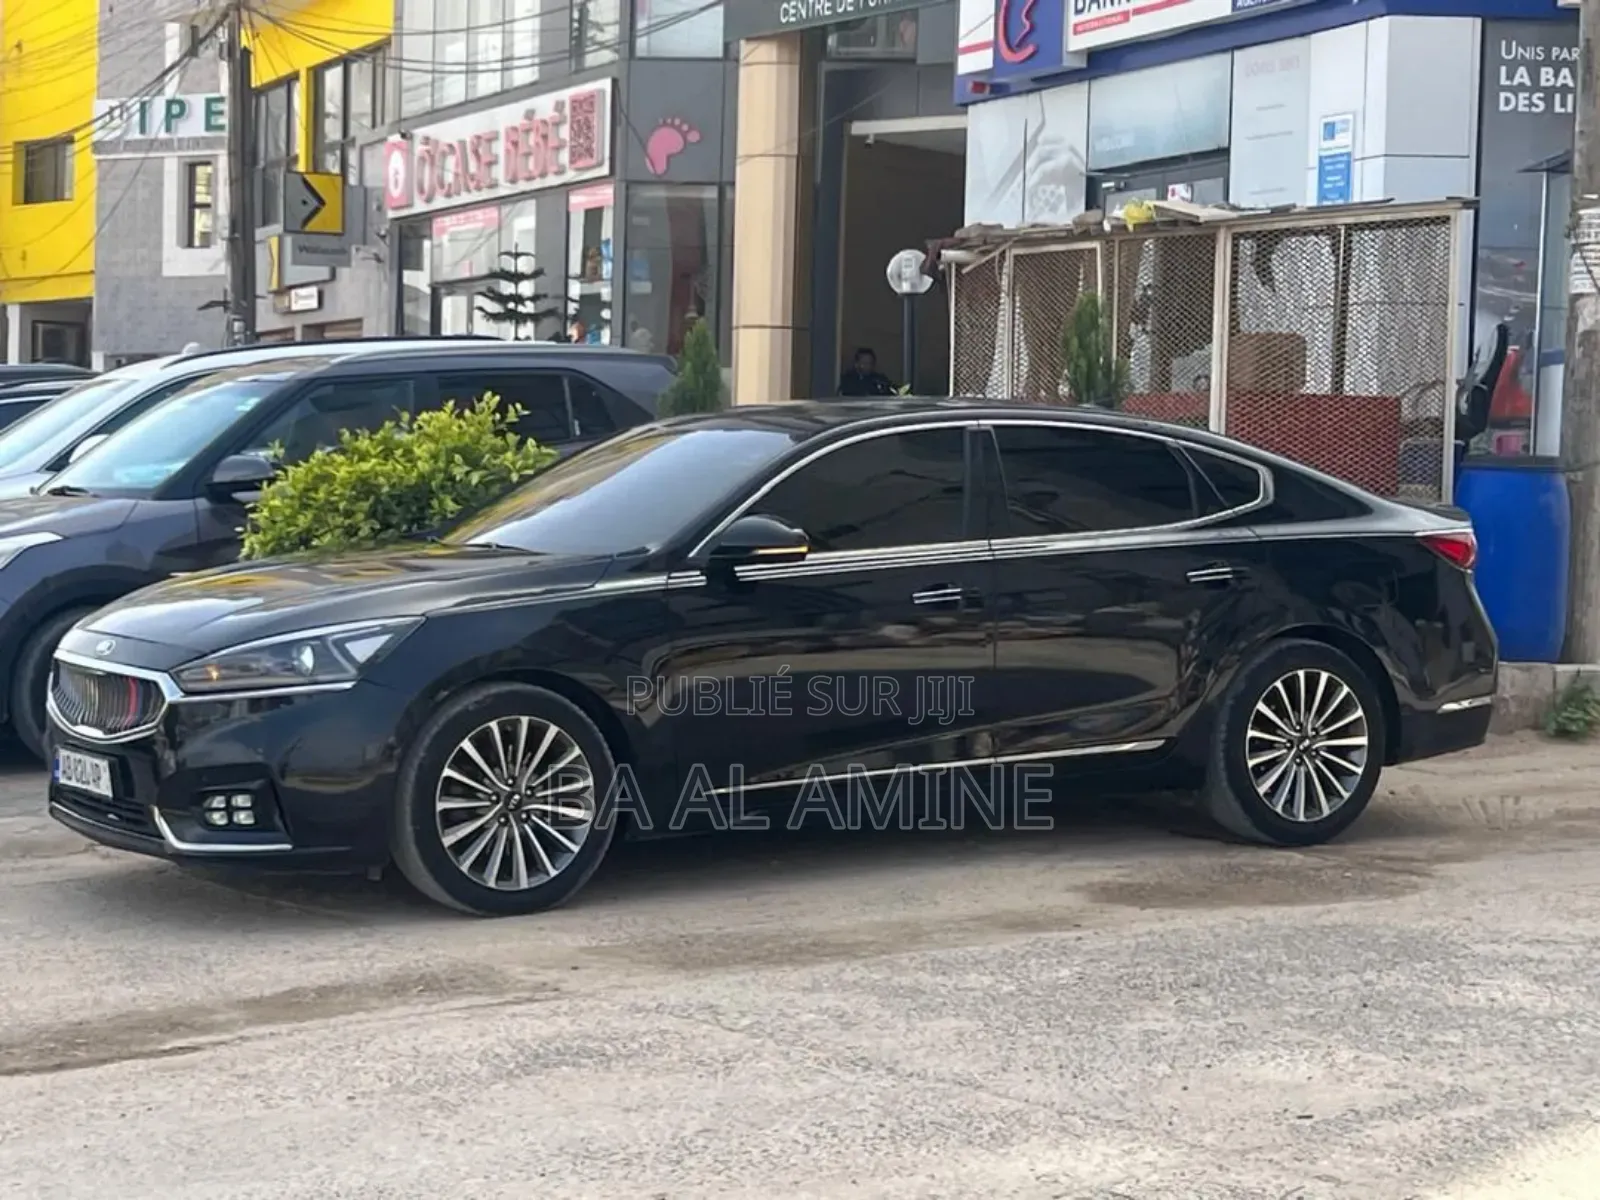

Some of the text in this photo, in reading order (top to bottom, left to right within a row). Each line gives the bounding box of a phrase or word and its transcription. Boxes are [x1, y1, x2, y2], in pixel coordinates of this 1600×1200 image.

[780, 0, 832, 23] CENTRE
[1500, 65, 1532, 87] LA
[1499, 92, 1545, 113] DES
[504, 99, 568, 185] BÉBÉ
